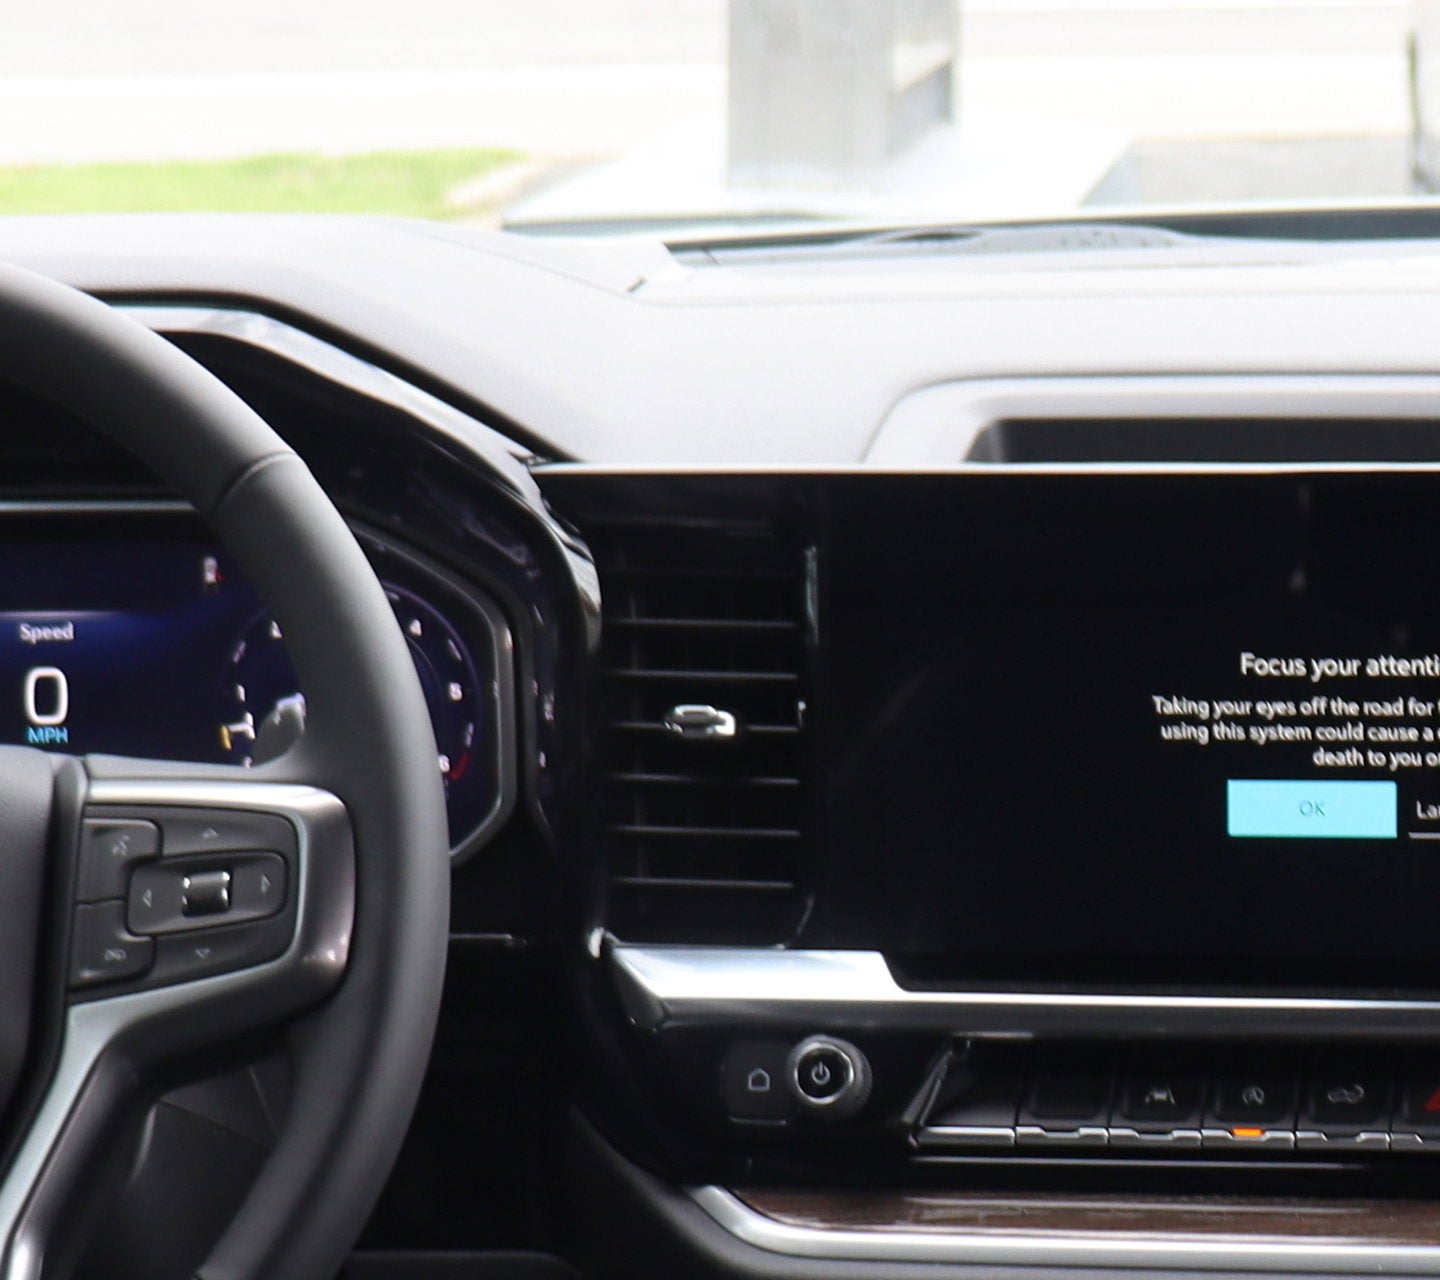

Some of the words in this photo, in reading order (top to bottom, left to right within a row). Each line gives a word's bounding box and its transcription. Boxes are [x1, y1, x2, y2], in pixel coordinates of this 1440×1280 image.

[20, 621, 74, 644] Speed
[1240, 652, 1307, 677] Focus
[1310, 658, 1362, 682] your
[24, 667, 68, 725] 0
[1151, 695, 1210, 720] Taking
[1212, 700, 1253, 720] your
[1255, 701, 1297, 720] eyes
[1299, 696, 1328, 716] off
[1329, 696, 1360, 716] the
[1363, 696, 1405, 716] road
[1407, 696, 1435, 717] for
[28, 726, 68, 743] MPH
[1160, 722, 1210, 745] using
[1212, 720, 1247, 741] this
[1249, 723, 1313, 745] system
[1315, 721, 1365, 741] could
[1367, 726, 1420, 742] cause
[1422, 726, 1435, 742] a
[1312, 746, 1365, 767] death
[1366, 749, 1387, 767] to
[1389, 751, 1423, 771] you
[1299, 800, 1326, 817] OK
